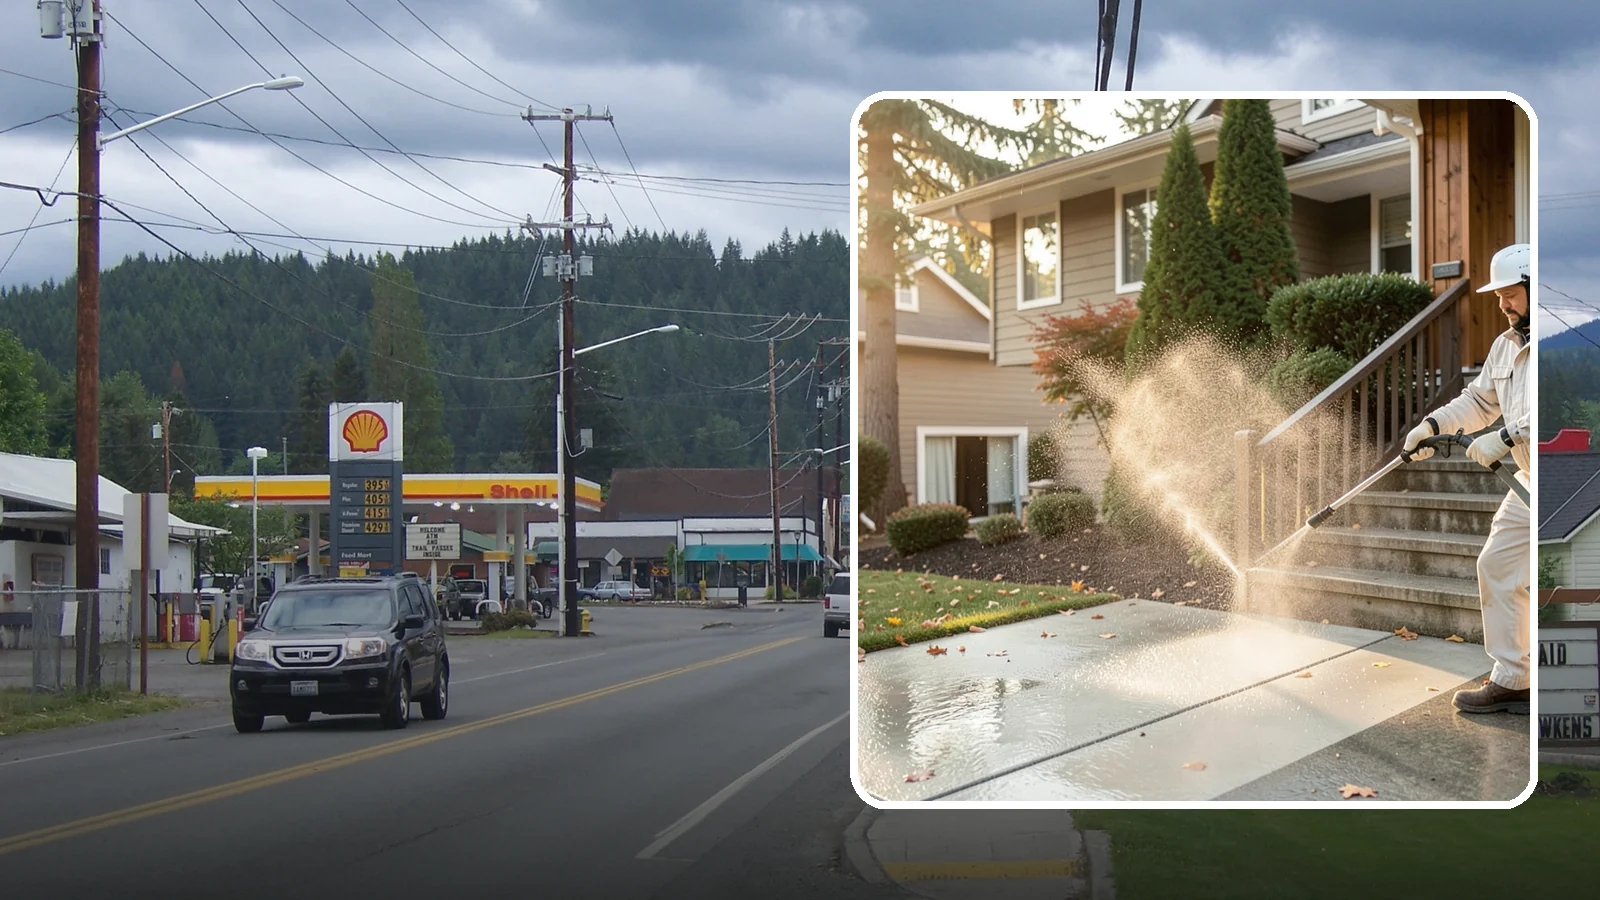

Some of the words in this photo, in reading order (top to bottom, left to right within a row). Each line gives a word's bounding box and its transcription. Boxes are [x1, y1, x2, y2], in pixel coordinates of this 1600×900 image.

[366, 480, 383, 490] 395
[490, 484, 547, 499] Shell
[366, 494, 383, 504] 405
[366, 508, 383, 518] 415
[366, 522, 383, 533] 429
[1539, 642, 1567, 666] AID
